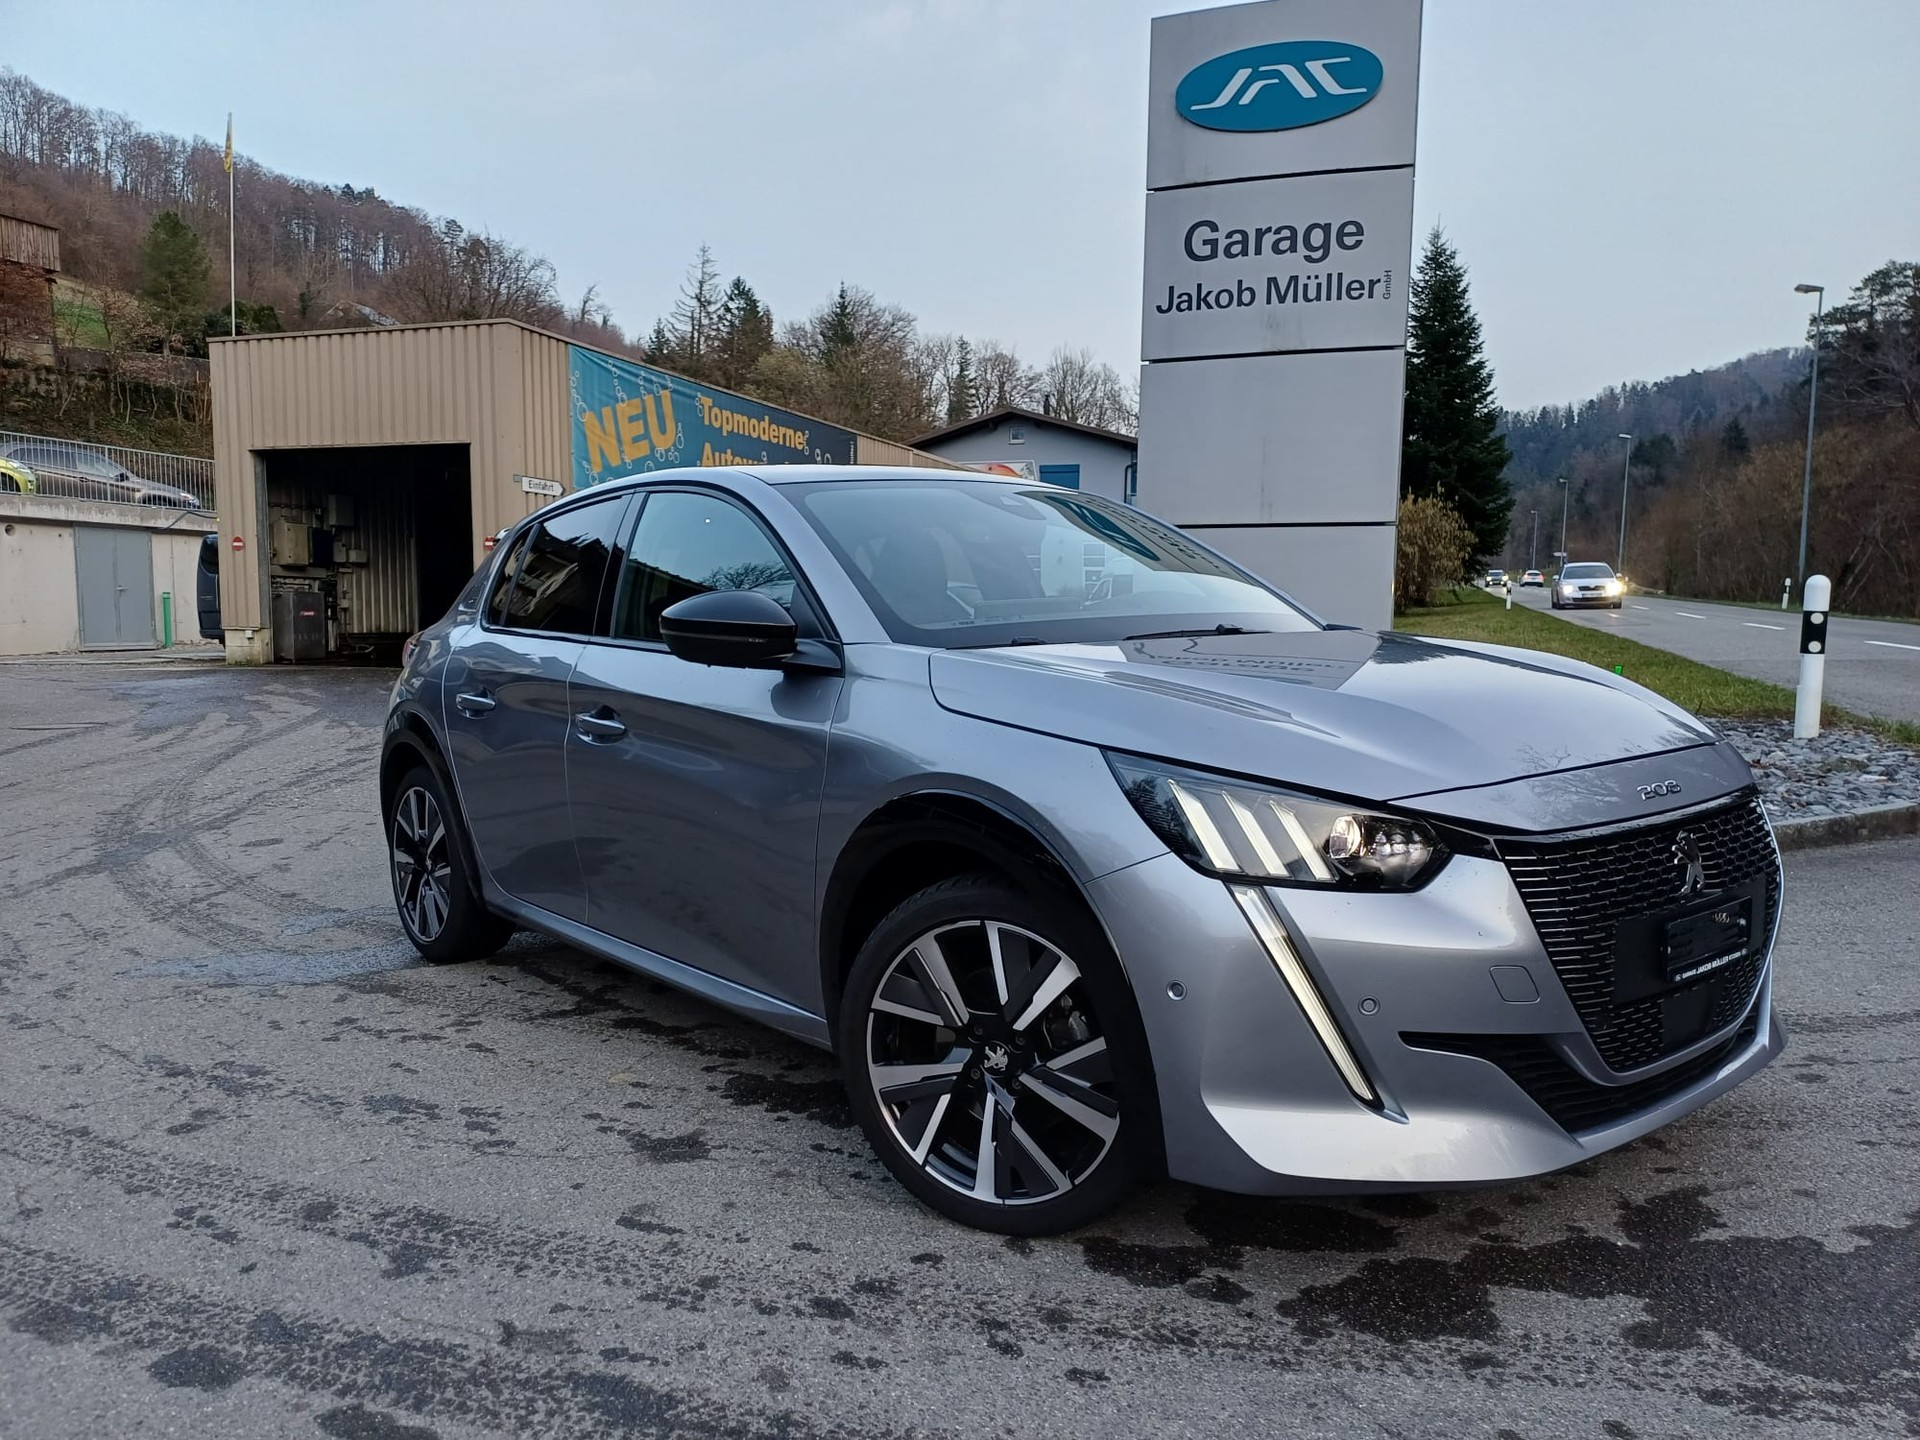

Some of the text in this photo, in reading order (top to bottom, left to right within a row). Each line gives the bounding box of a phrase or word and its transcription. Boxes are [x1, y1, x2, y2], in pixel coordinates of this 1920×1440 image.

[1183, 219, 1365, 264] Garage
[1155, 272, 1382, 315] Jakob Müller
[1382, 269, 1393, 300] GmbH
[581, 389, 677, 473] NEU
[700, 396, 805, 450] Topmoderne
[528, 479, 554, 492] Einfahrt
[1636, 779, 1682, 801] 208
